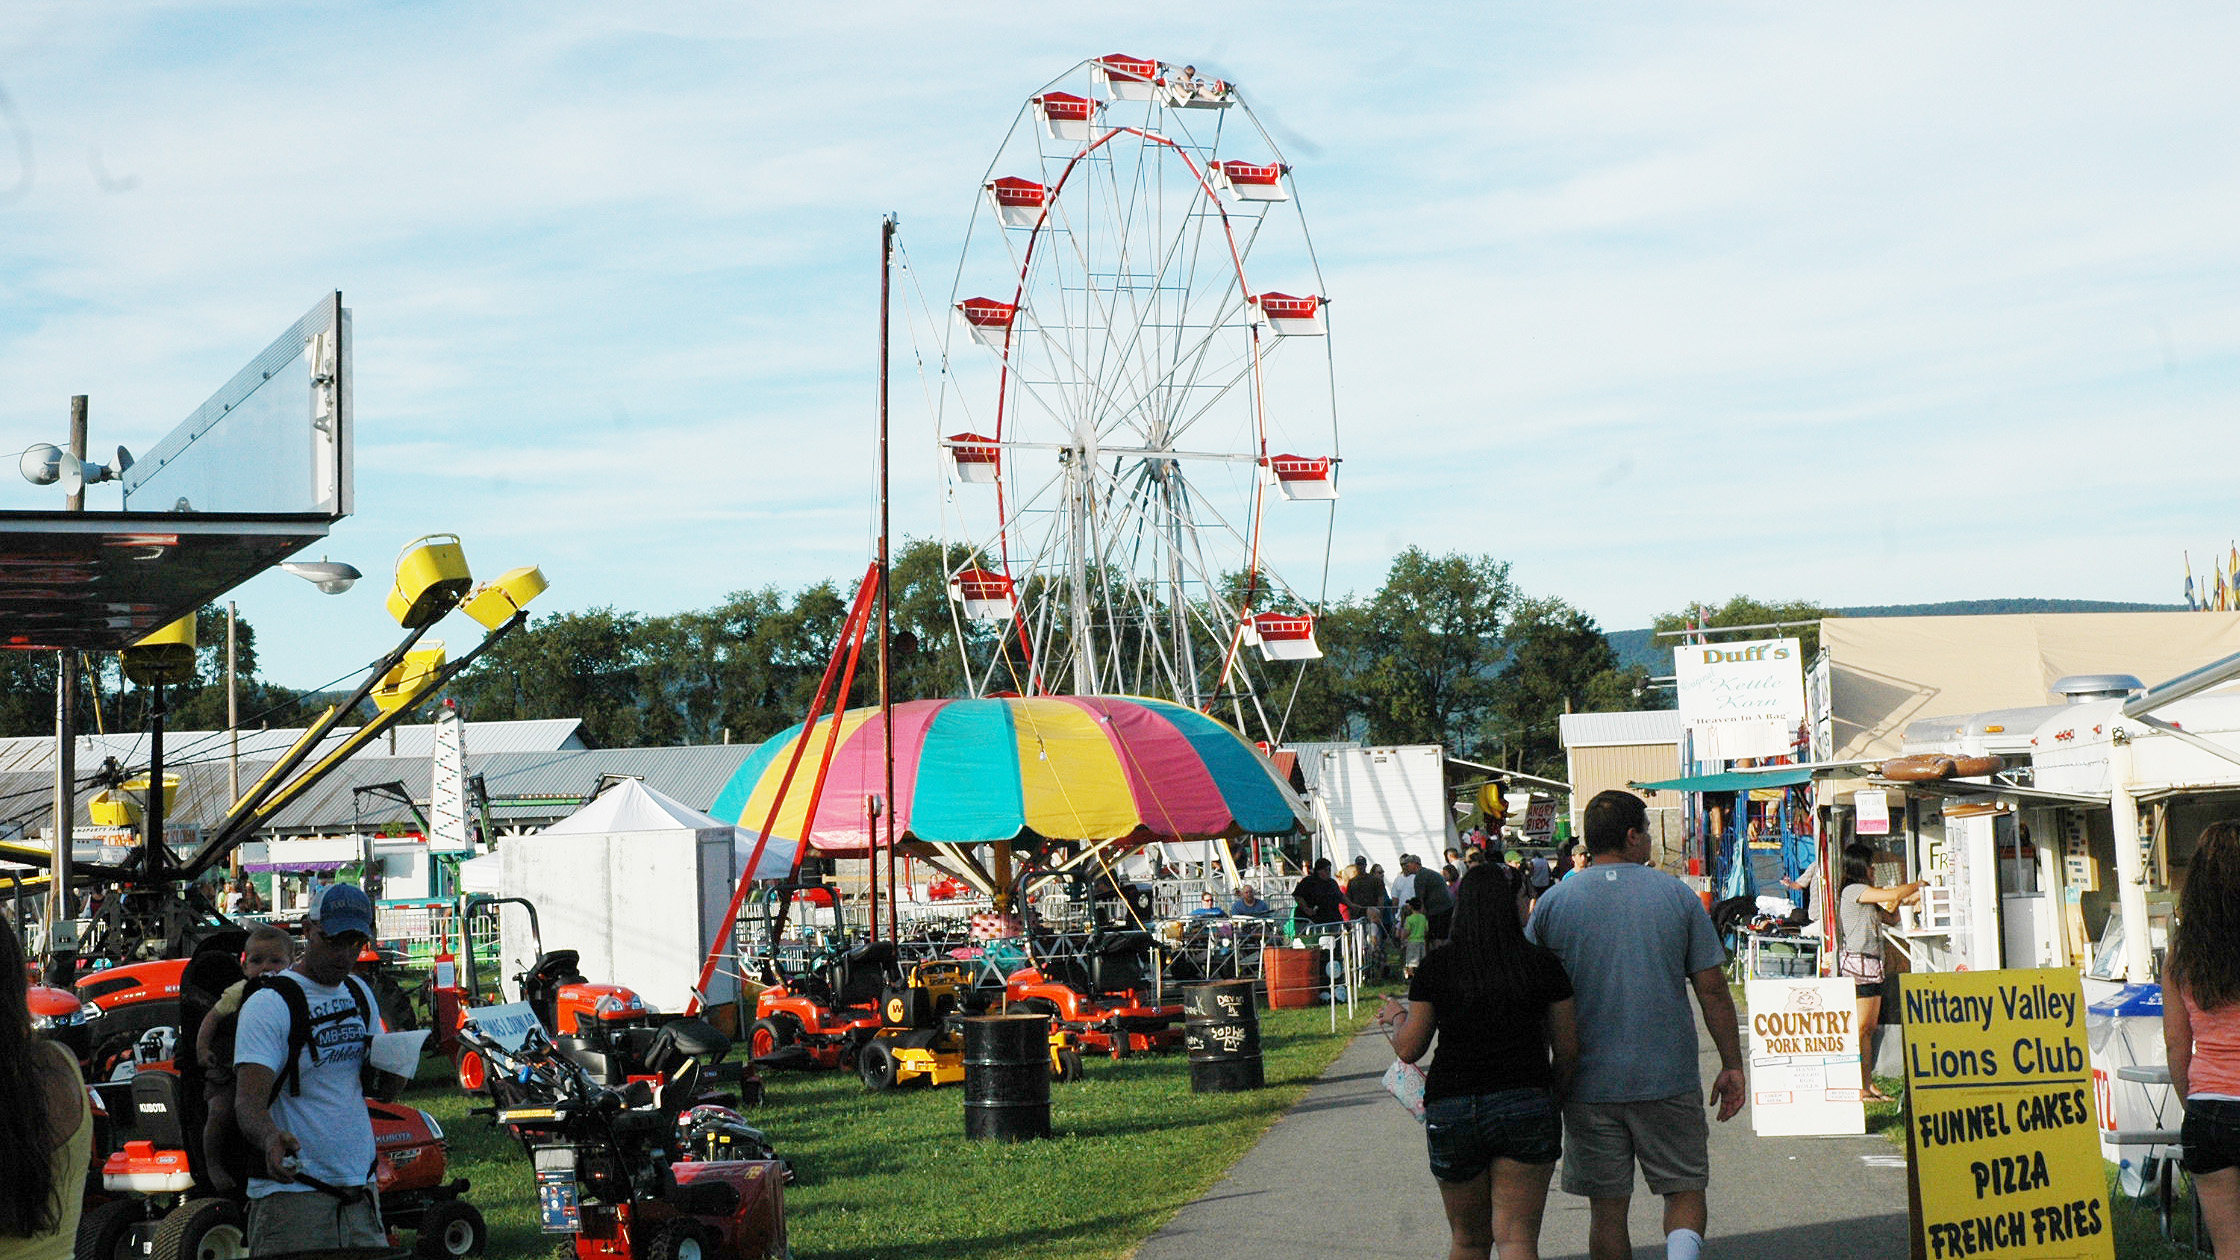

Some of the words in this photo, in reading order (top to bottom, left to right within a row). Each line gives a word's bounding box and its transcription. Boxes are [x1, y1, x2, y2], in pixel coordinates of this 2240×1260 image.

[1703, 643, 1790, 664] Duff's
[1754, 1010, 1852, 1037] COUNTRY
[1905, 990, 1994, 1031] Nittany
[1998, 983, 2076, 1027] Valley
[1766, 1037, 1801, 1054] PORK
[1804, 1035, 1845, 1053] RINDS
[1911, 1042, 1997, 1079] Lions
[2012, 1037, 2084, 1076] Club
[139, 1103, 167, 1113] KUBOTA
[1918, 1102, 2011, 1148] FUNNEL
[2016, 1089, 2088, 1131] CAKES
[1971, 1150, 2049, 1200] PIZZA
[1928, 1211, 2026, 1260] FRENCH
[2031, 1198, 2103, 1246] FRIES
